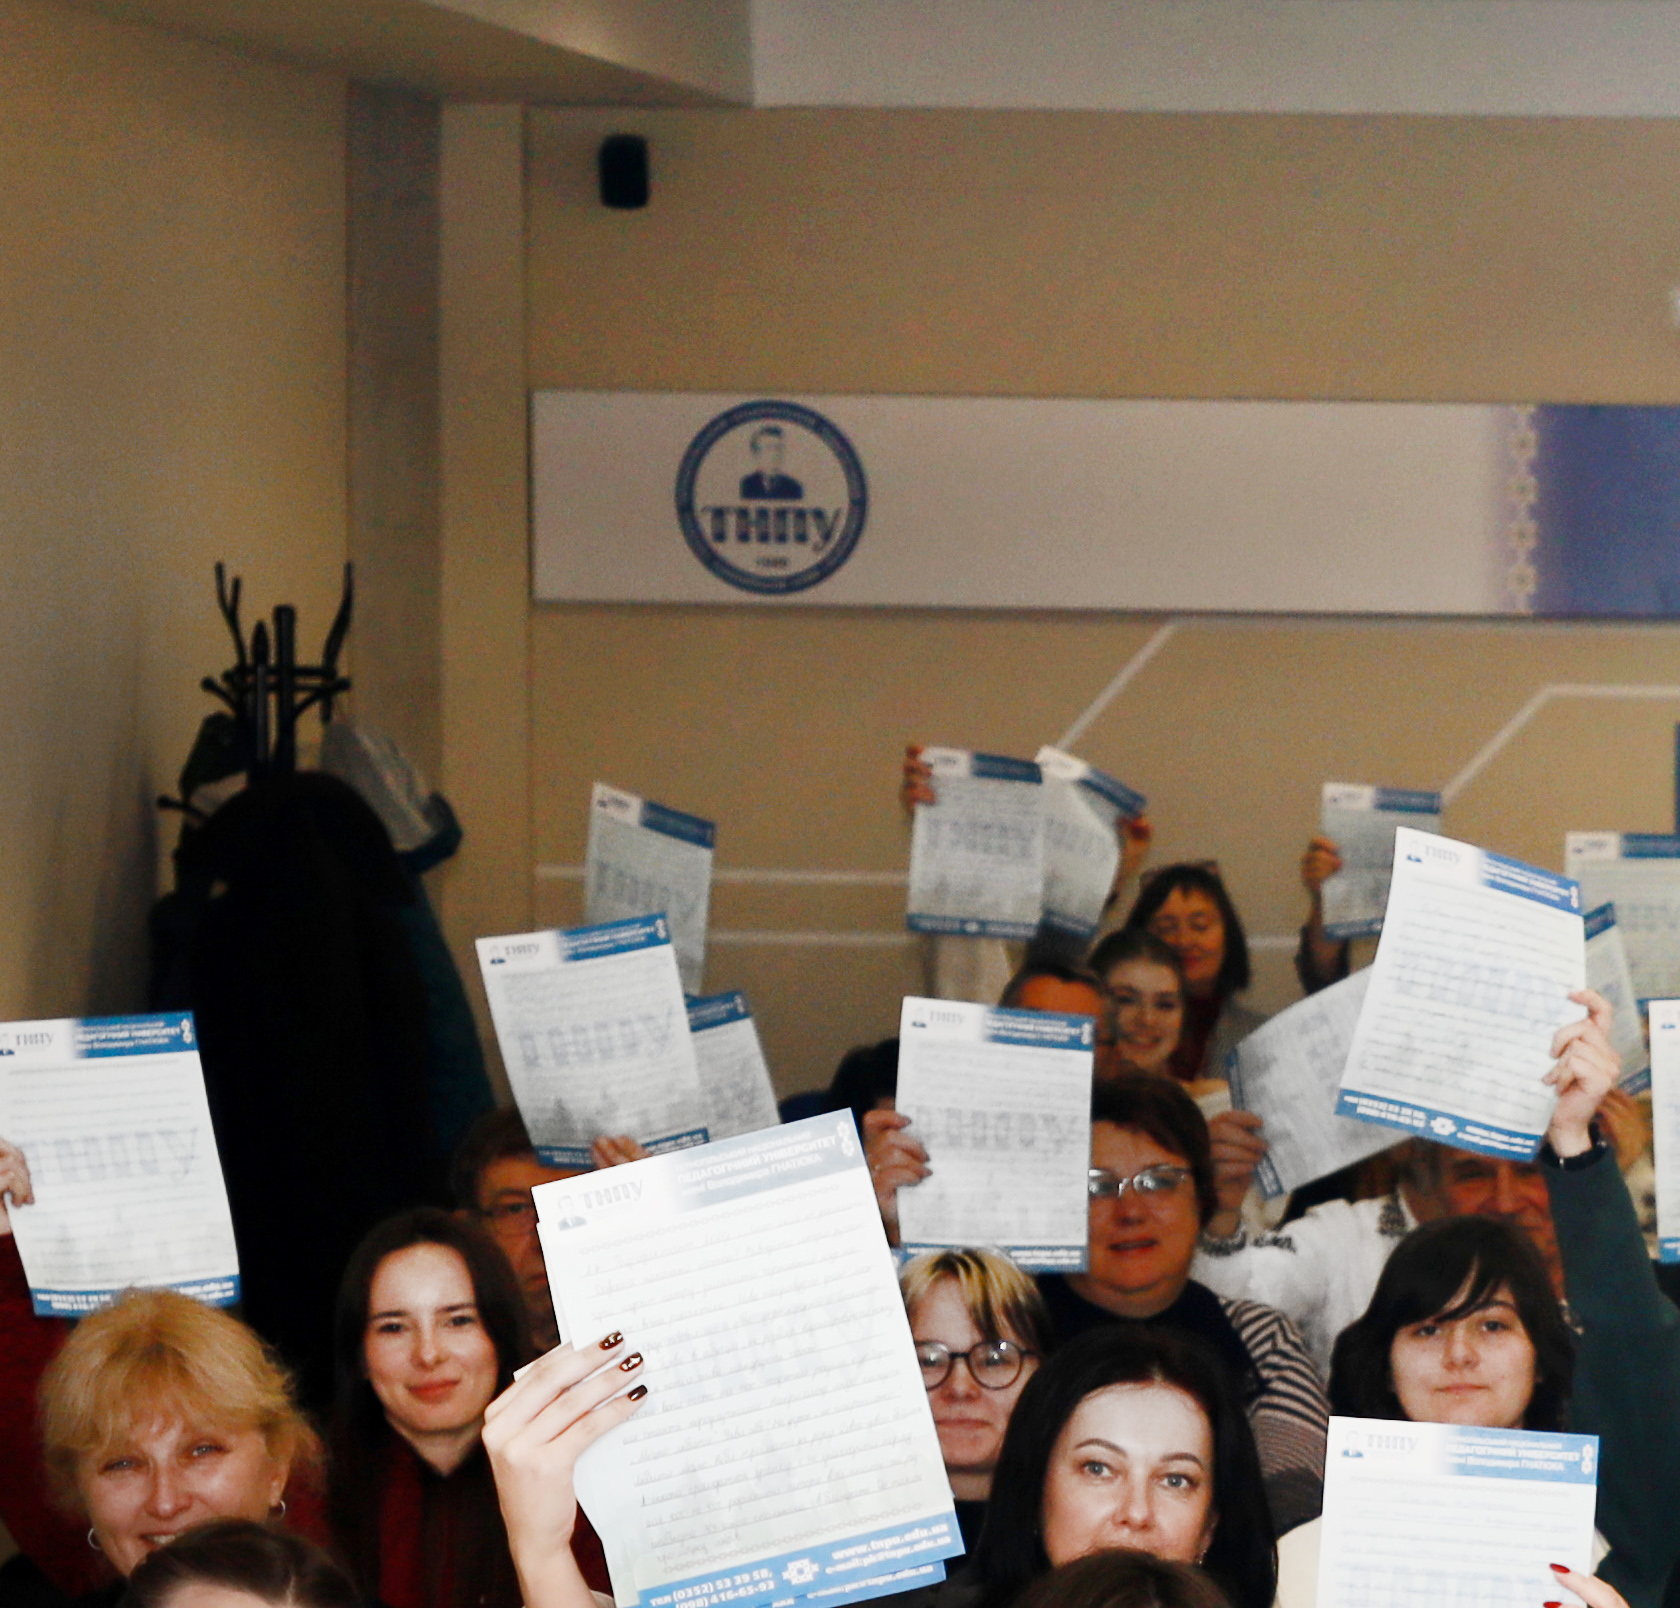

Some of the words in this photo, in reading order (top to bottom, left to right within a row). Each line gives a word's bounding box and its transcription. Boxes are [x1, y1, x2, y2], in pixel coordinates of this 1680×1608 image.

[702, 505, 842, 553] ТНПУ
[762, 1134, 838, 1163] УНІВЕРСИТЕТ
[580, 1178, 644, 1211] ТНПУ
[649, 1594, 671, 1607] тел
[672, 1582, 715, 1602] (0352)
[715, 1577, 731, 1590] 53
[734, 1572, 751, 1585] 39
[753, 1567, 773, 1581] 58,
[710, 1580, 776, 1604] 416-65-93
